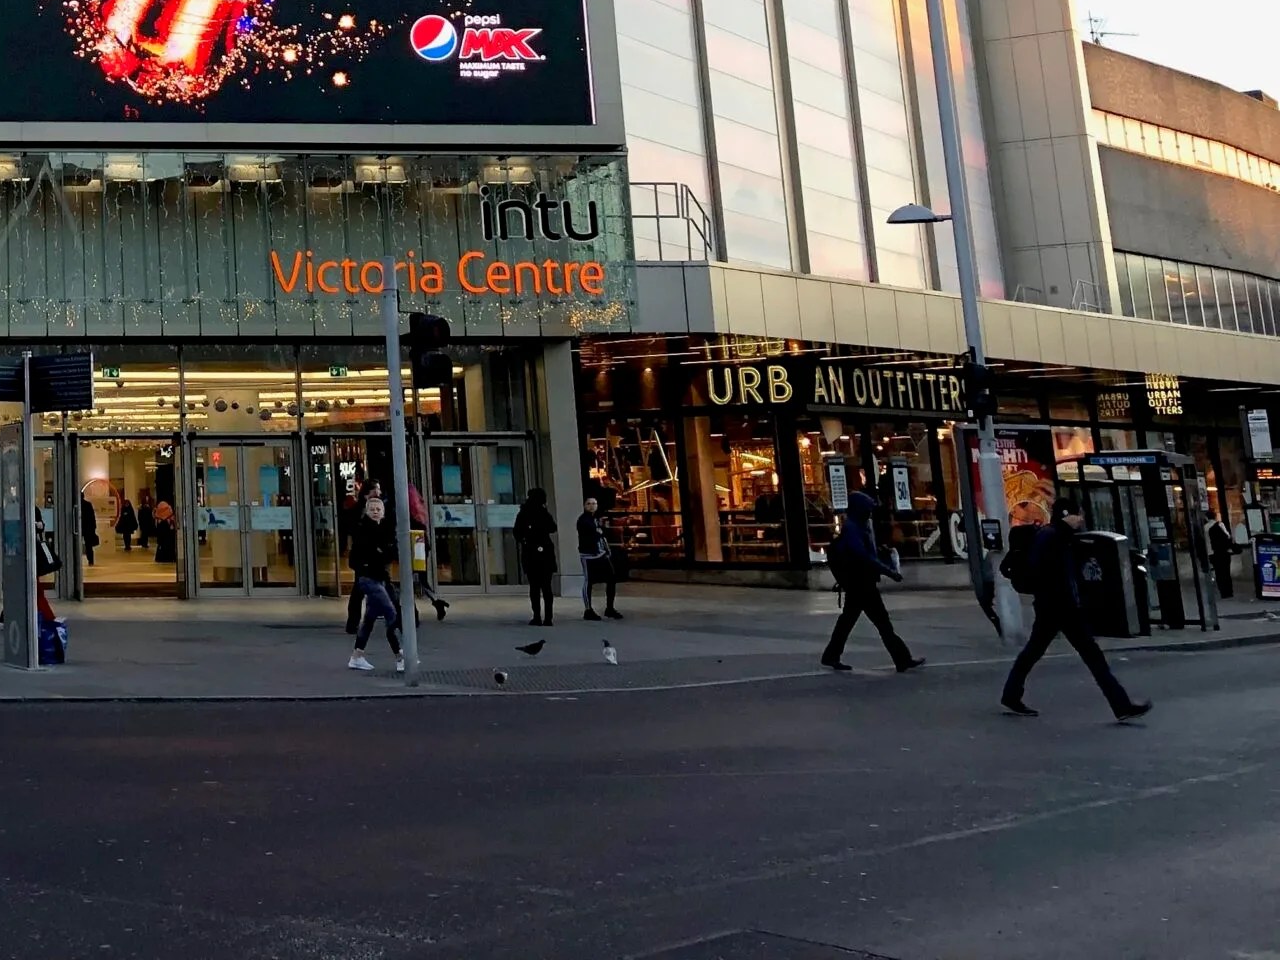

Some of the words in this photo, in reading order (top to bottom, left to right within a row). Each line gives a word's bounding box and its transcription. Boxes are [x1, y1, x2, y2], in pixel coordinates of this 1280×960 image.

[464, 13, 500, 26] pepsi
[459, 28, 543, 61] MAX
[459, 62, 500, 70] MAXIMUM
[501, 62, 525, 71] TASTE
[473, 70, 499, 79] sugar
[480, 186, 599, 242] intu
[457, 251, 605, 295] Centre
[1147, 390, 1181, 400] URBAN
[1148, 399, 1182, 407] OUTFI-
[1155, 406, 1183, 414] TTERS
[971, 448, 1028, 463] MHTY
